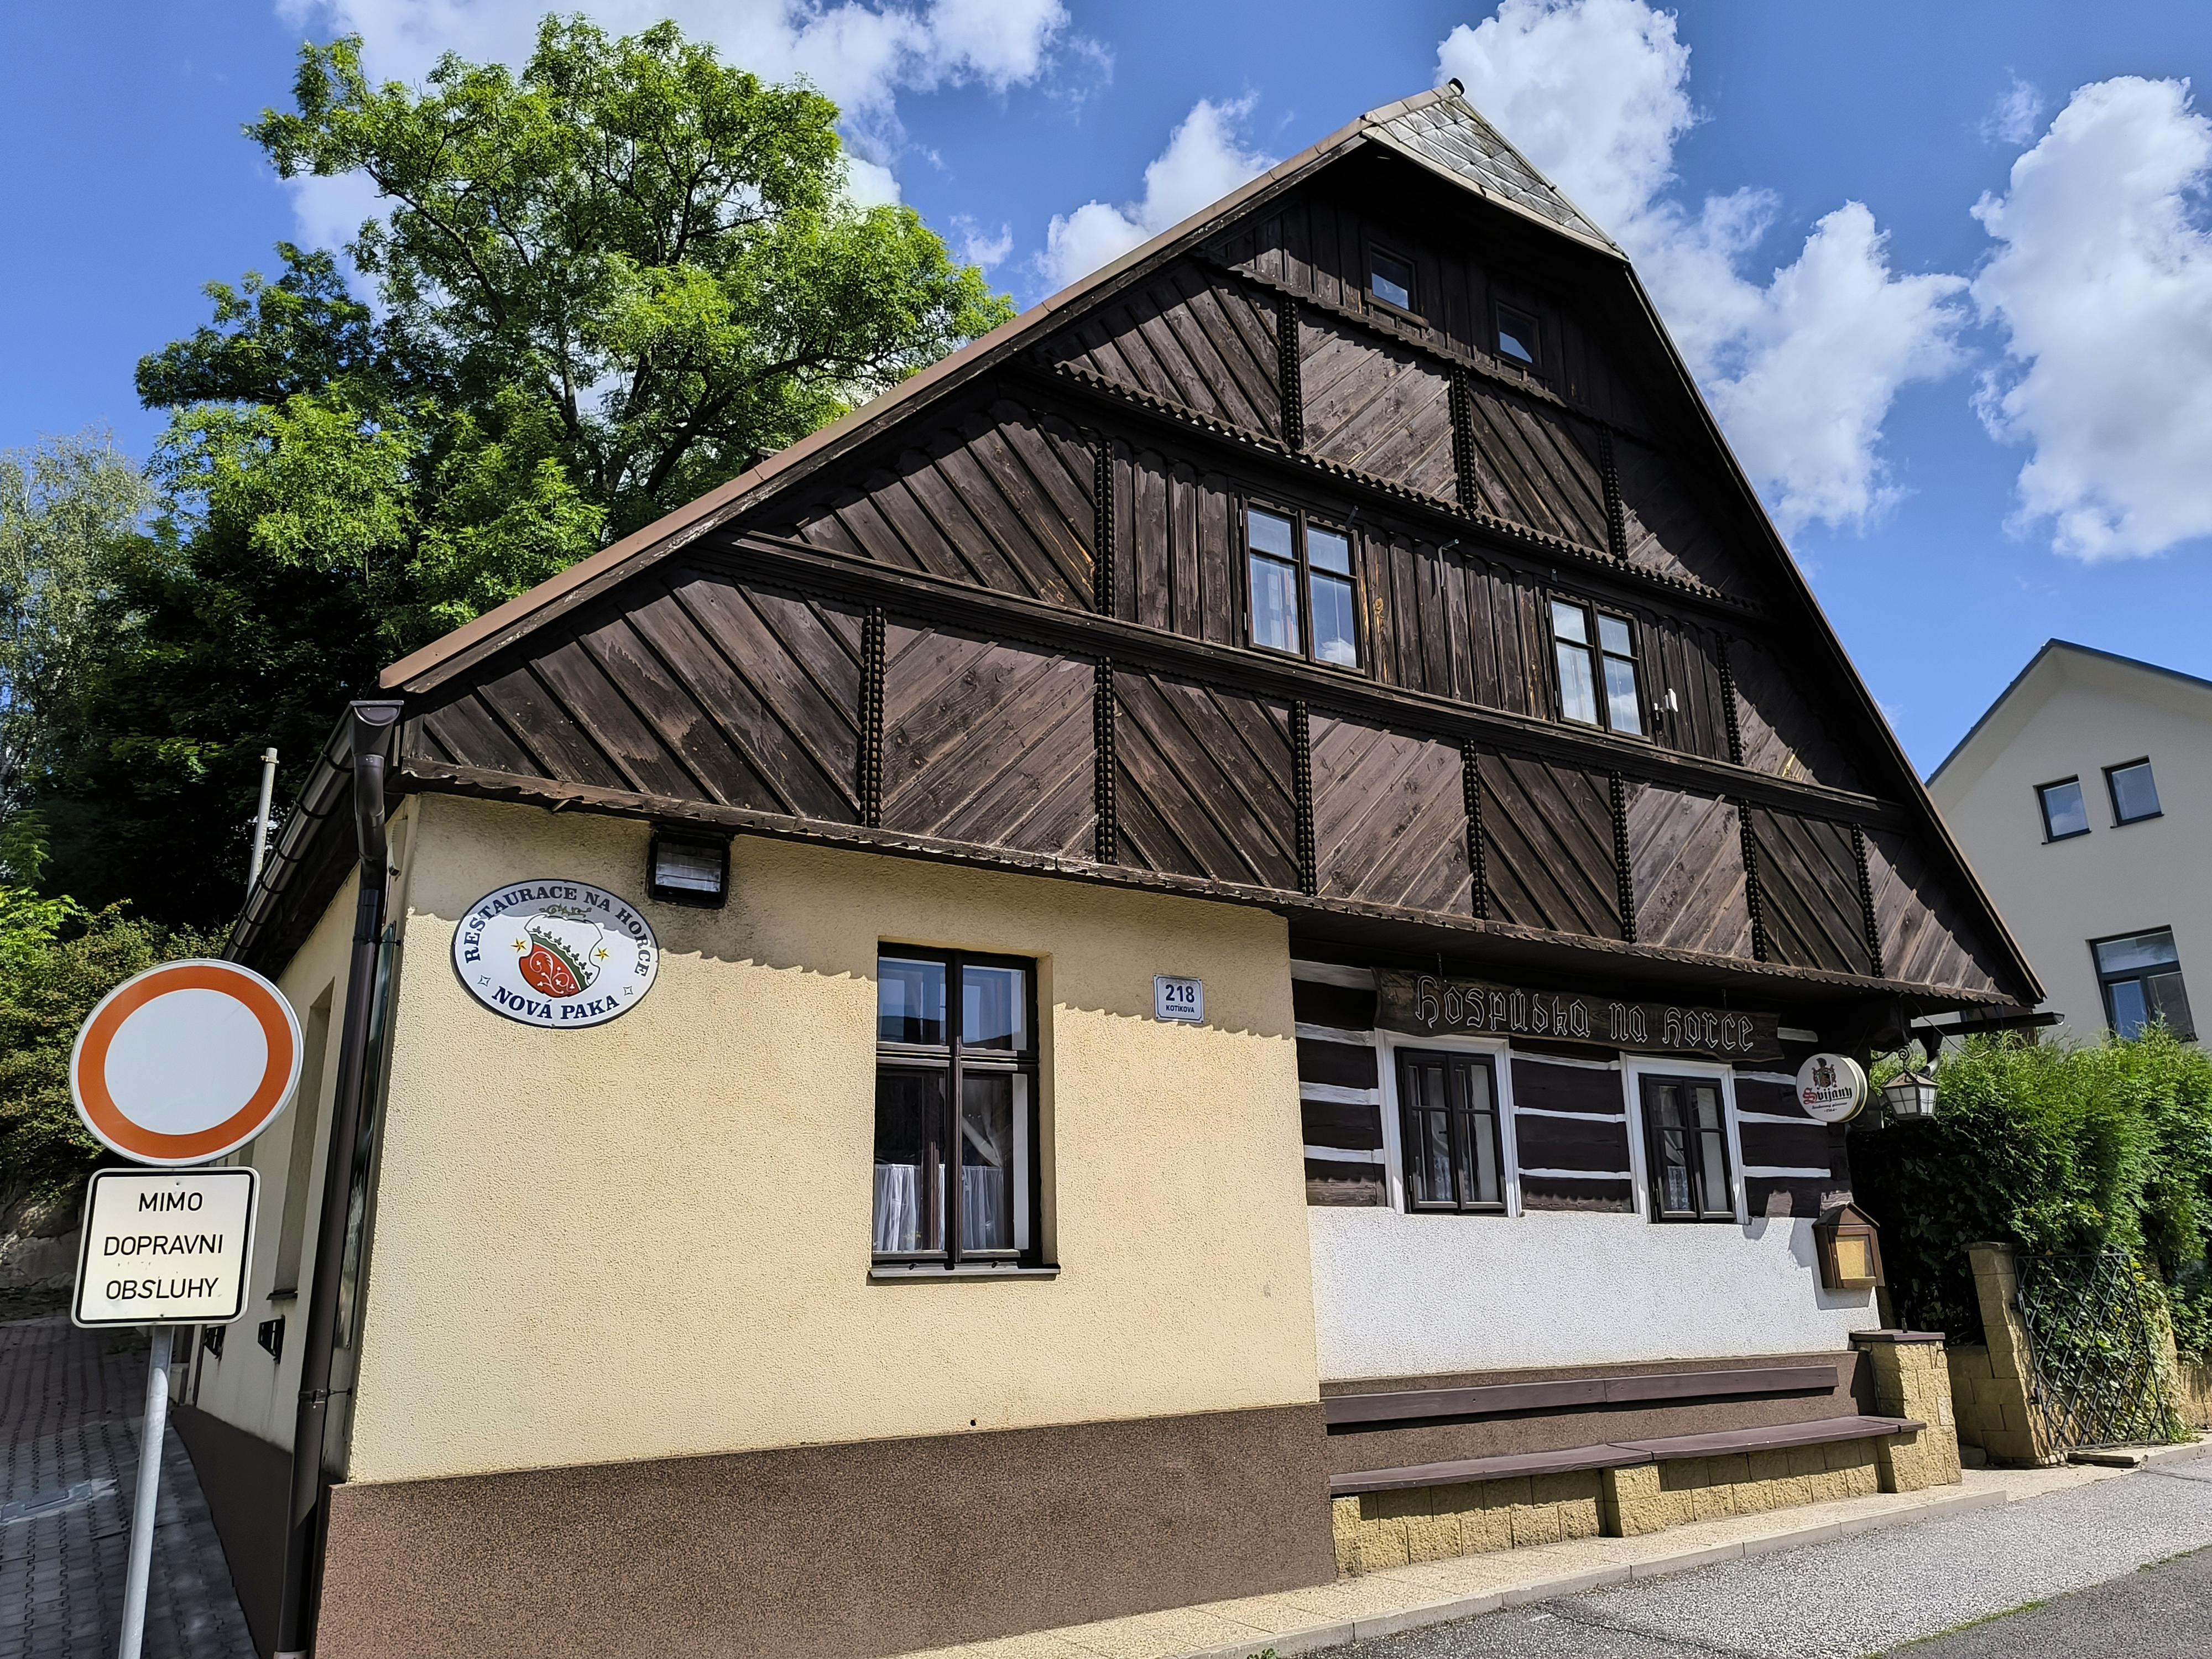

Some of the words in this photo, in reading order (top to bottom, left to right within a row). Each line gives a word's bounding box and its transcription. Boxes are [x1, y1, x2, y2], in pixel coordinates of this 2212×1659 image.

[464, 886, 577, 964] RESTAURACE
[583, 891, 613, 912] NA
[615, 907, 652, 977] HORCE
[492, 985, 552, 1019] NOVÁ
[560, 995, 619, 1019] PAKA
[1165, 984, 1194, 1003] 218
[1609, 1003, 1647, 1043] na
[1802, 1087, 1853, 1105] Svijany
[139, 1192, 203, 1212] MIMO
[103, 1234, 223, 1256] DOPRAVNI
[106, 1277, 219, 1300] OBSLUHY
